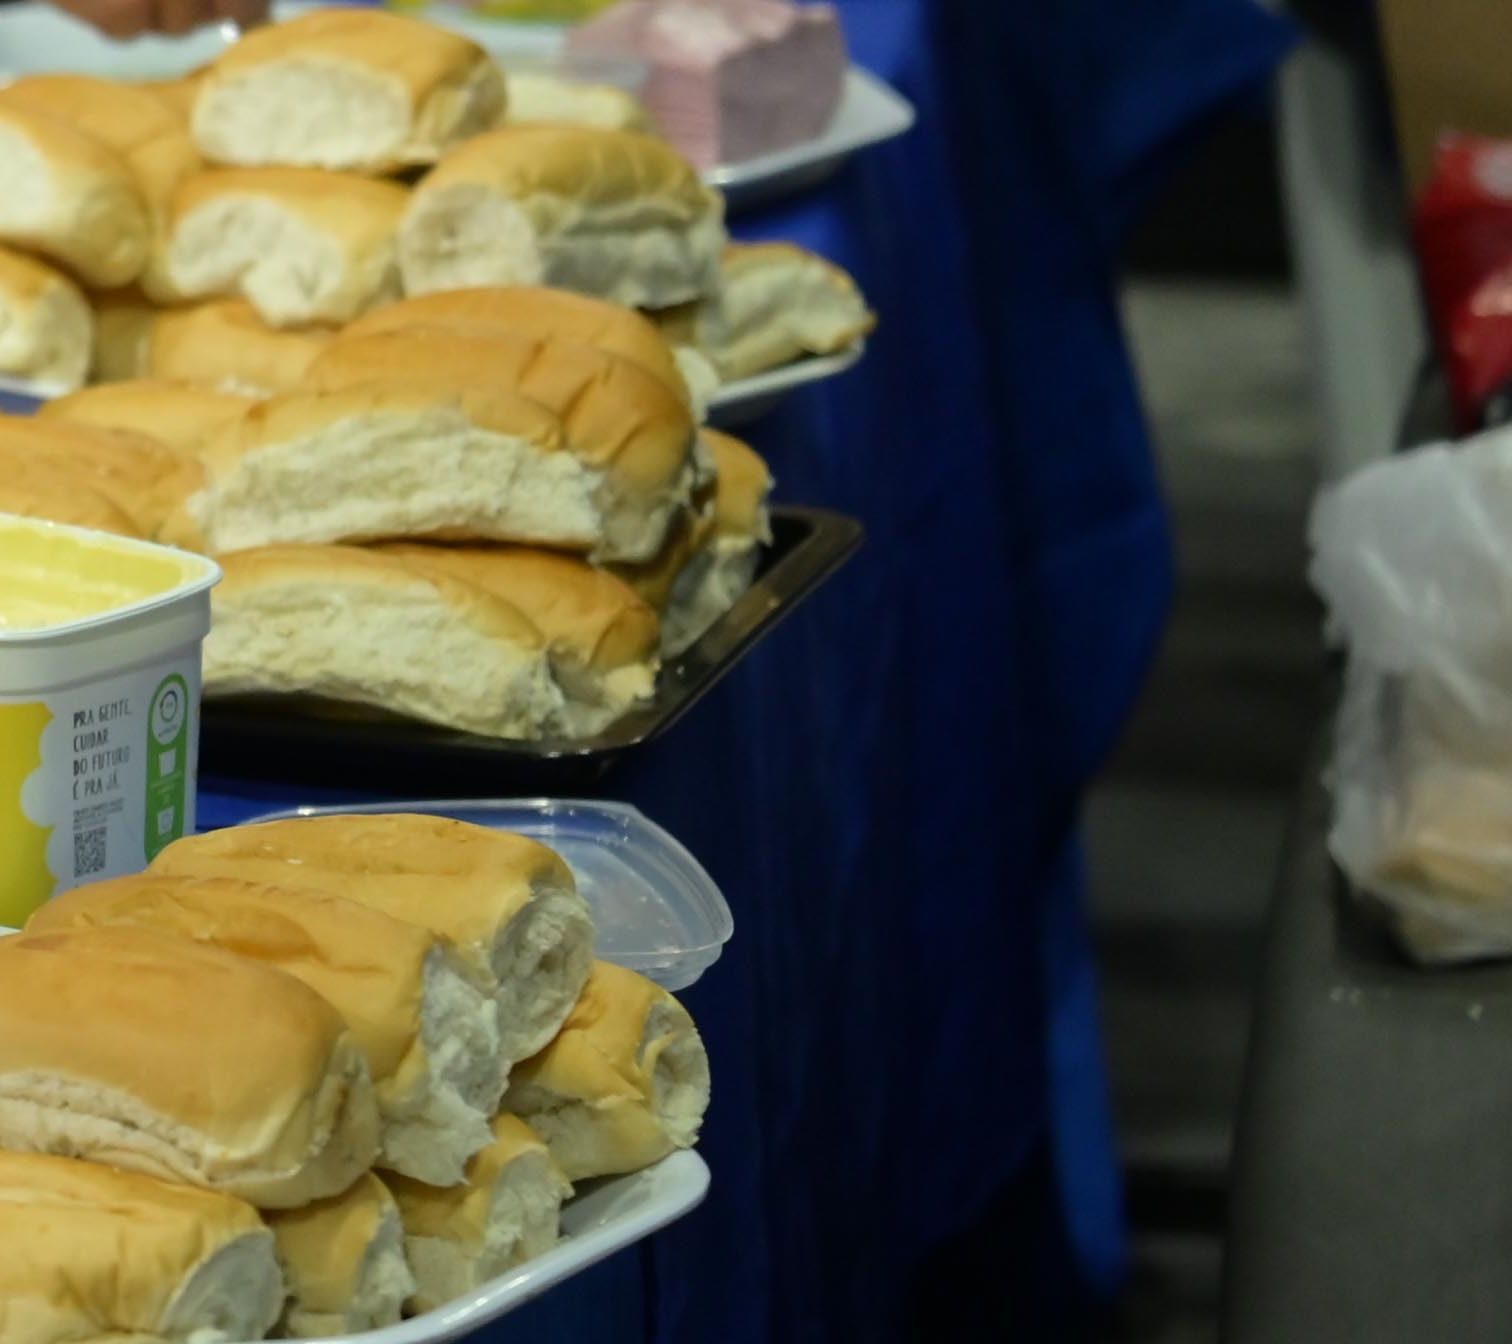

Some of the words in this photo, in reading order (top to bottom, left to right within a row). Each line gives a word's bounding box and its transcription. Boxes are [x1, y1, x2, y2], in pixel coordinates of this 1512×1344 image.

[73, 709, 95, 729] PRA
[73, 727, 110, 752] CUIDAR
[73, 757, 88, 777] DO
[91, 746, 131, 772] FUTURO
[84, 778, 103, 797] PRA
